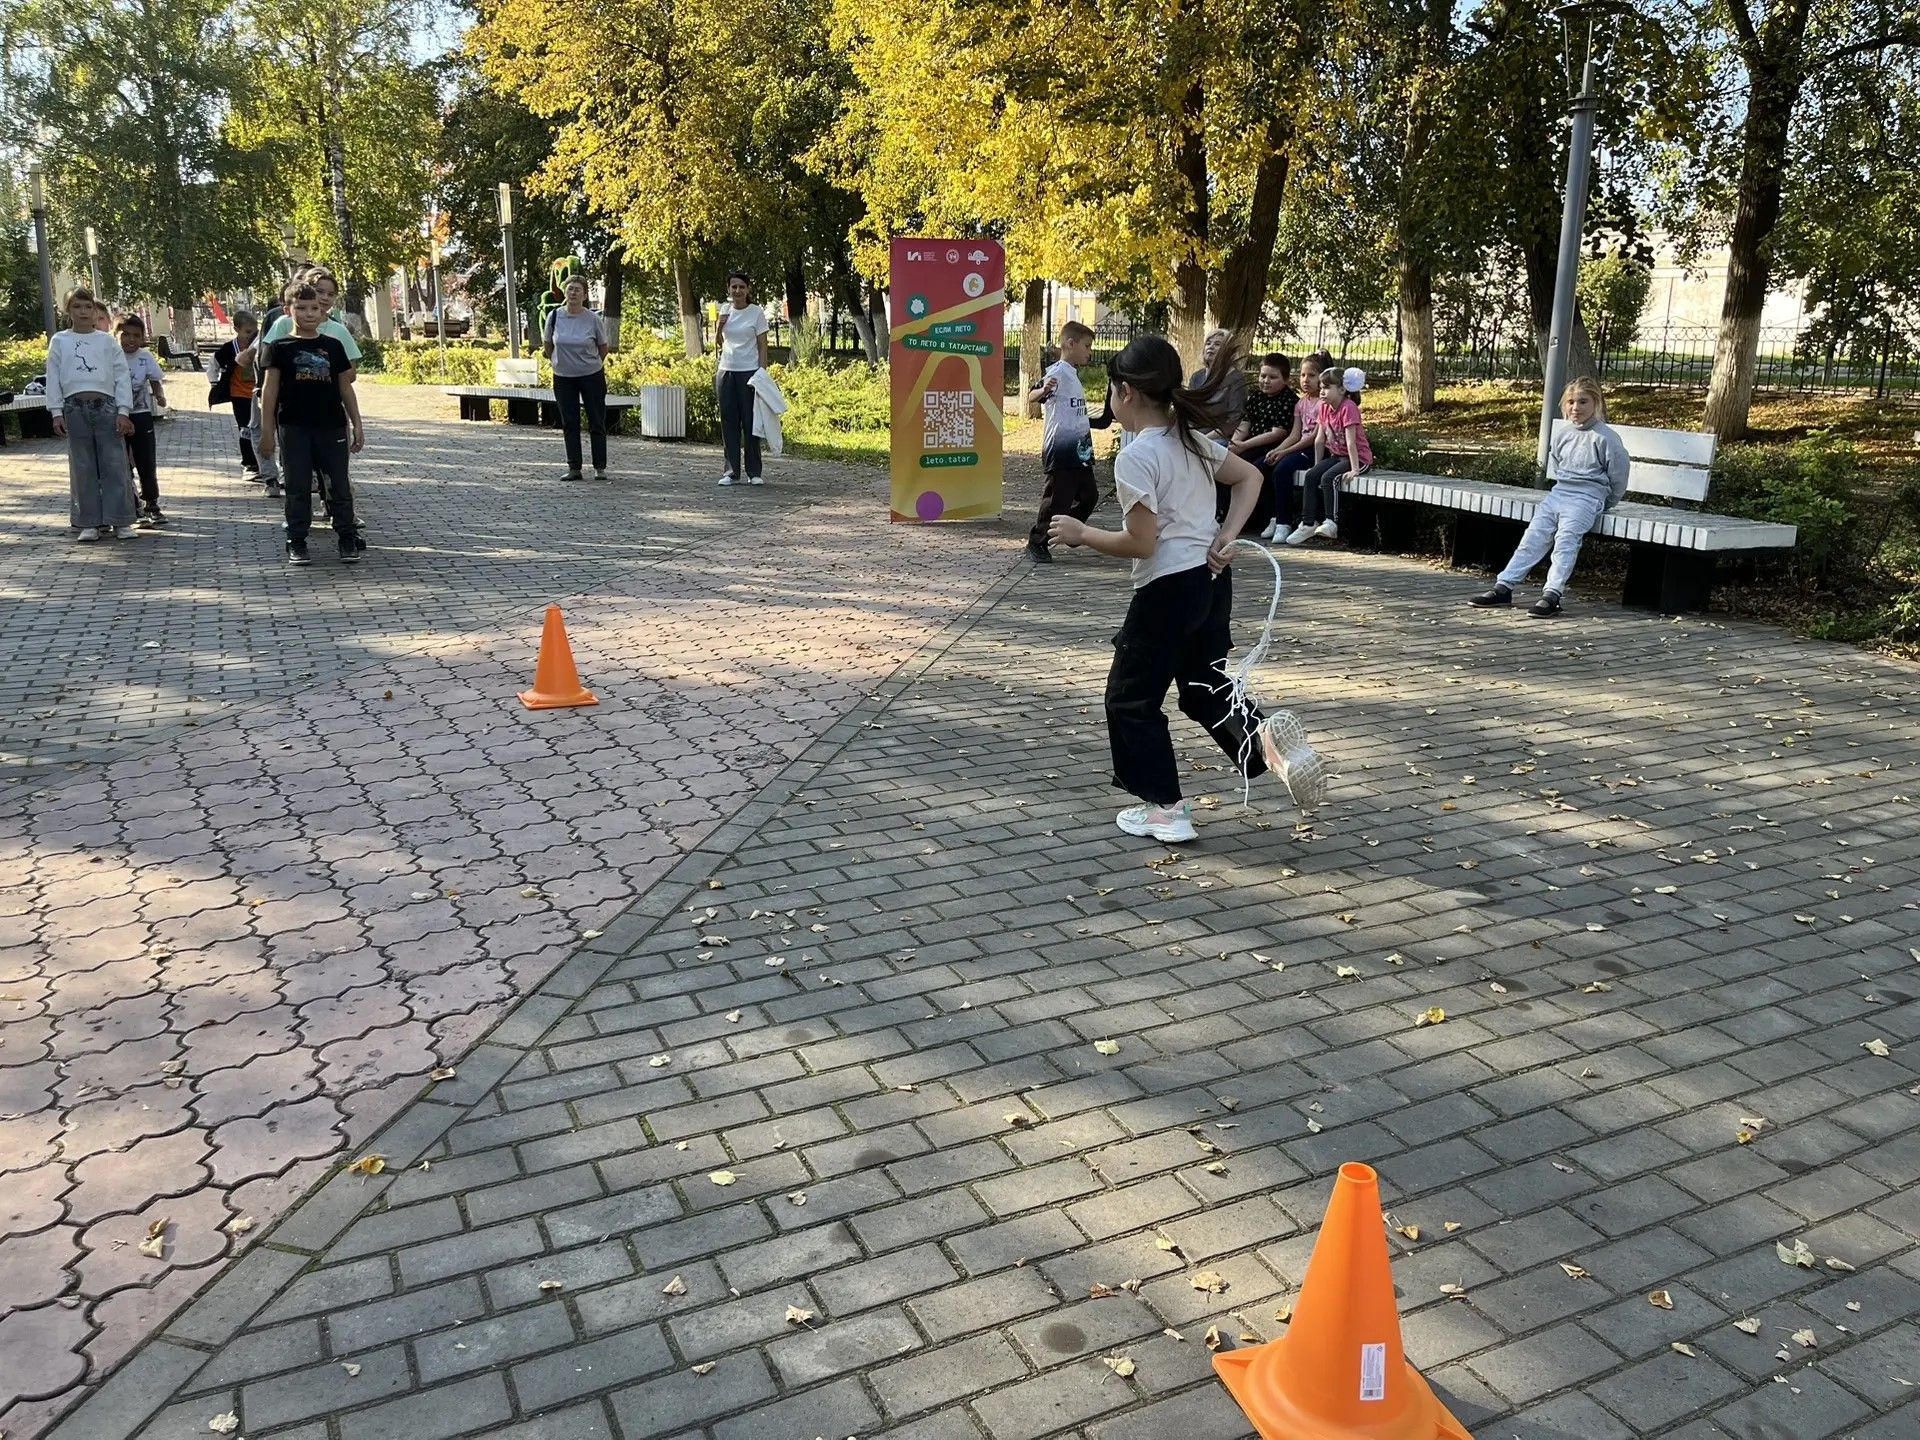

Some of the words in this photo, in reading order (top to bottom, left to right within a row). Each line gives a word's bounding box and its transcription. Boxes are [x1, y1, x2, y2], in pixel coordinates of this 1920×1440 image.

[935, 326, 951, 334] ЕСЛИ
[955, 325, 971, 333] ЛЕТО
[909, 338, 917, 346] ТО
[920, 340, 937, 348] ЛЕТО
[949, 342, 988, 353] ТАТАРСТАНЕ
[926, 455, 970, 464] leto.tatar
